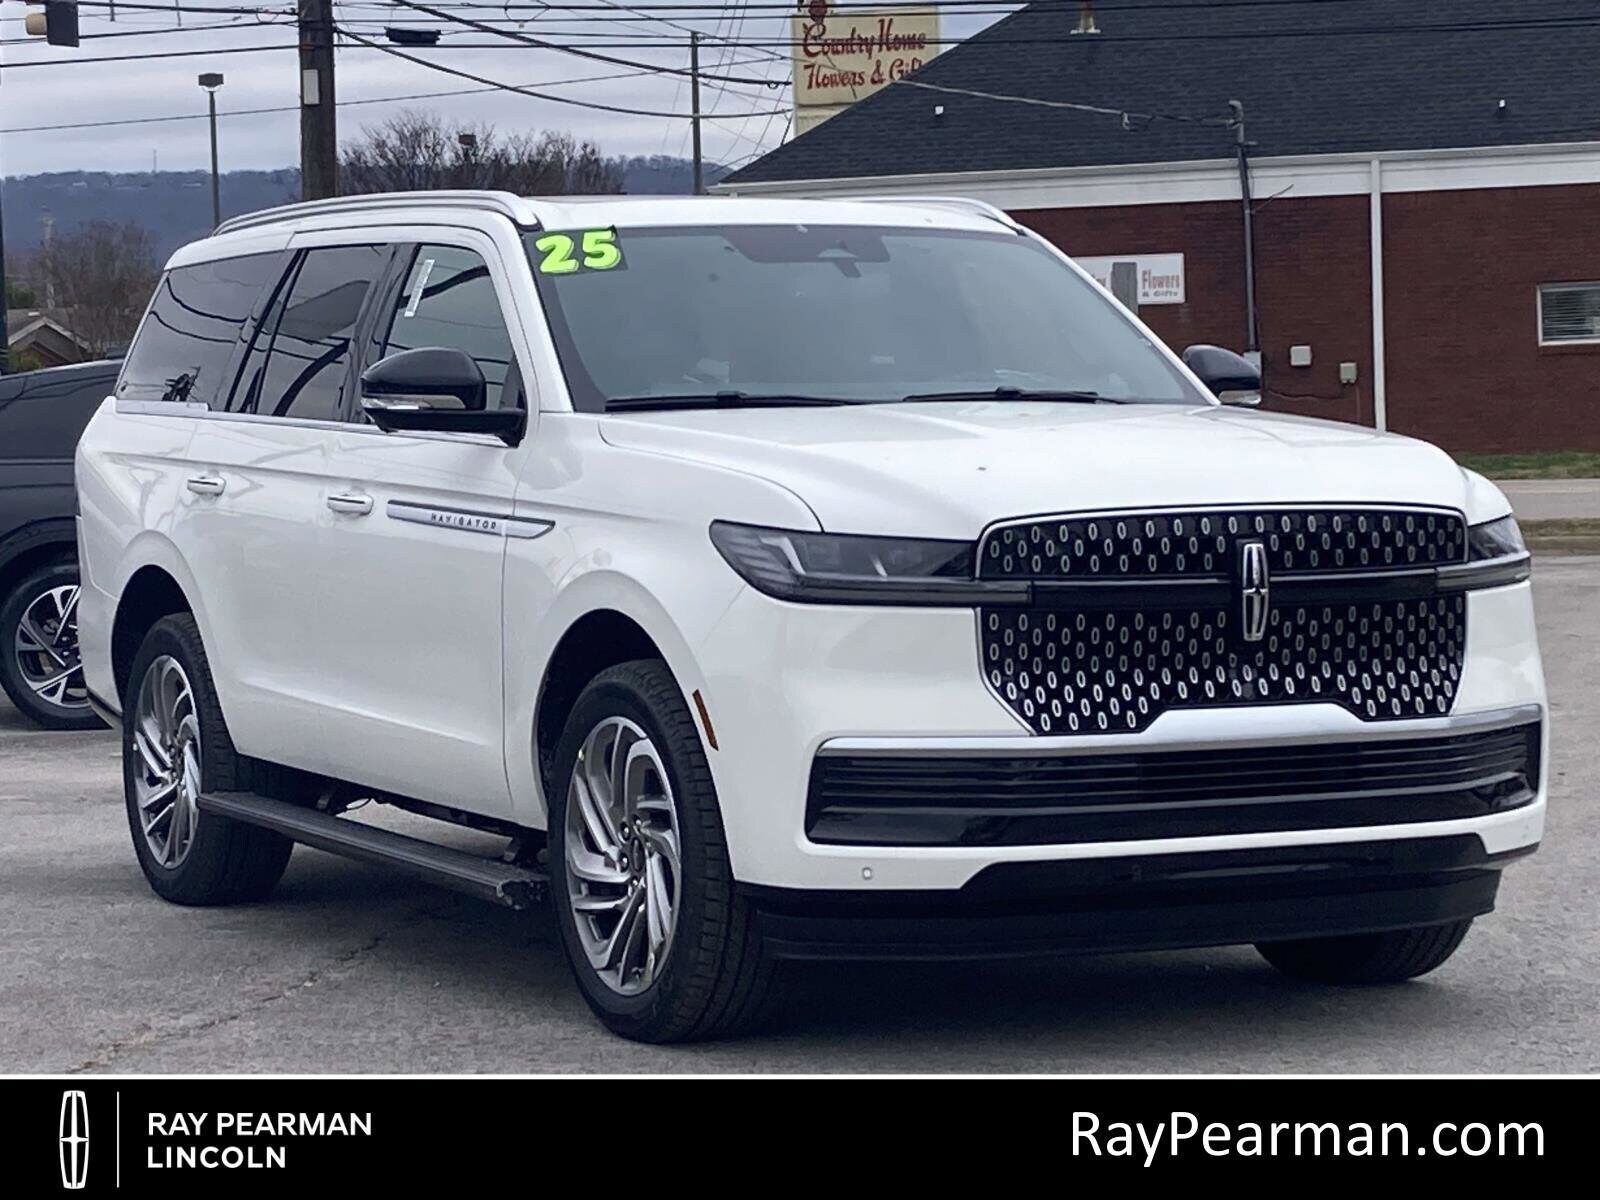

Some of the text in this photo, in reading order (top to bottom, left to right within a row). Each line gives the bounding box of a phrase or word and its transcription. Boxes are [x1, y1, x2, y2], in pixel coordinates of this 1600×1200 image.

[803, 18, 927, 60] Country Home
[803, 63, 866, 90] Flowers
[870, 59, 886, 85] &
[535, 230, 621, 273] 25
[1142, 269, 1180, 289] Flowers
[430, 512, 497, 530] NAVIGATOR
